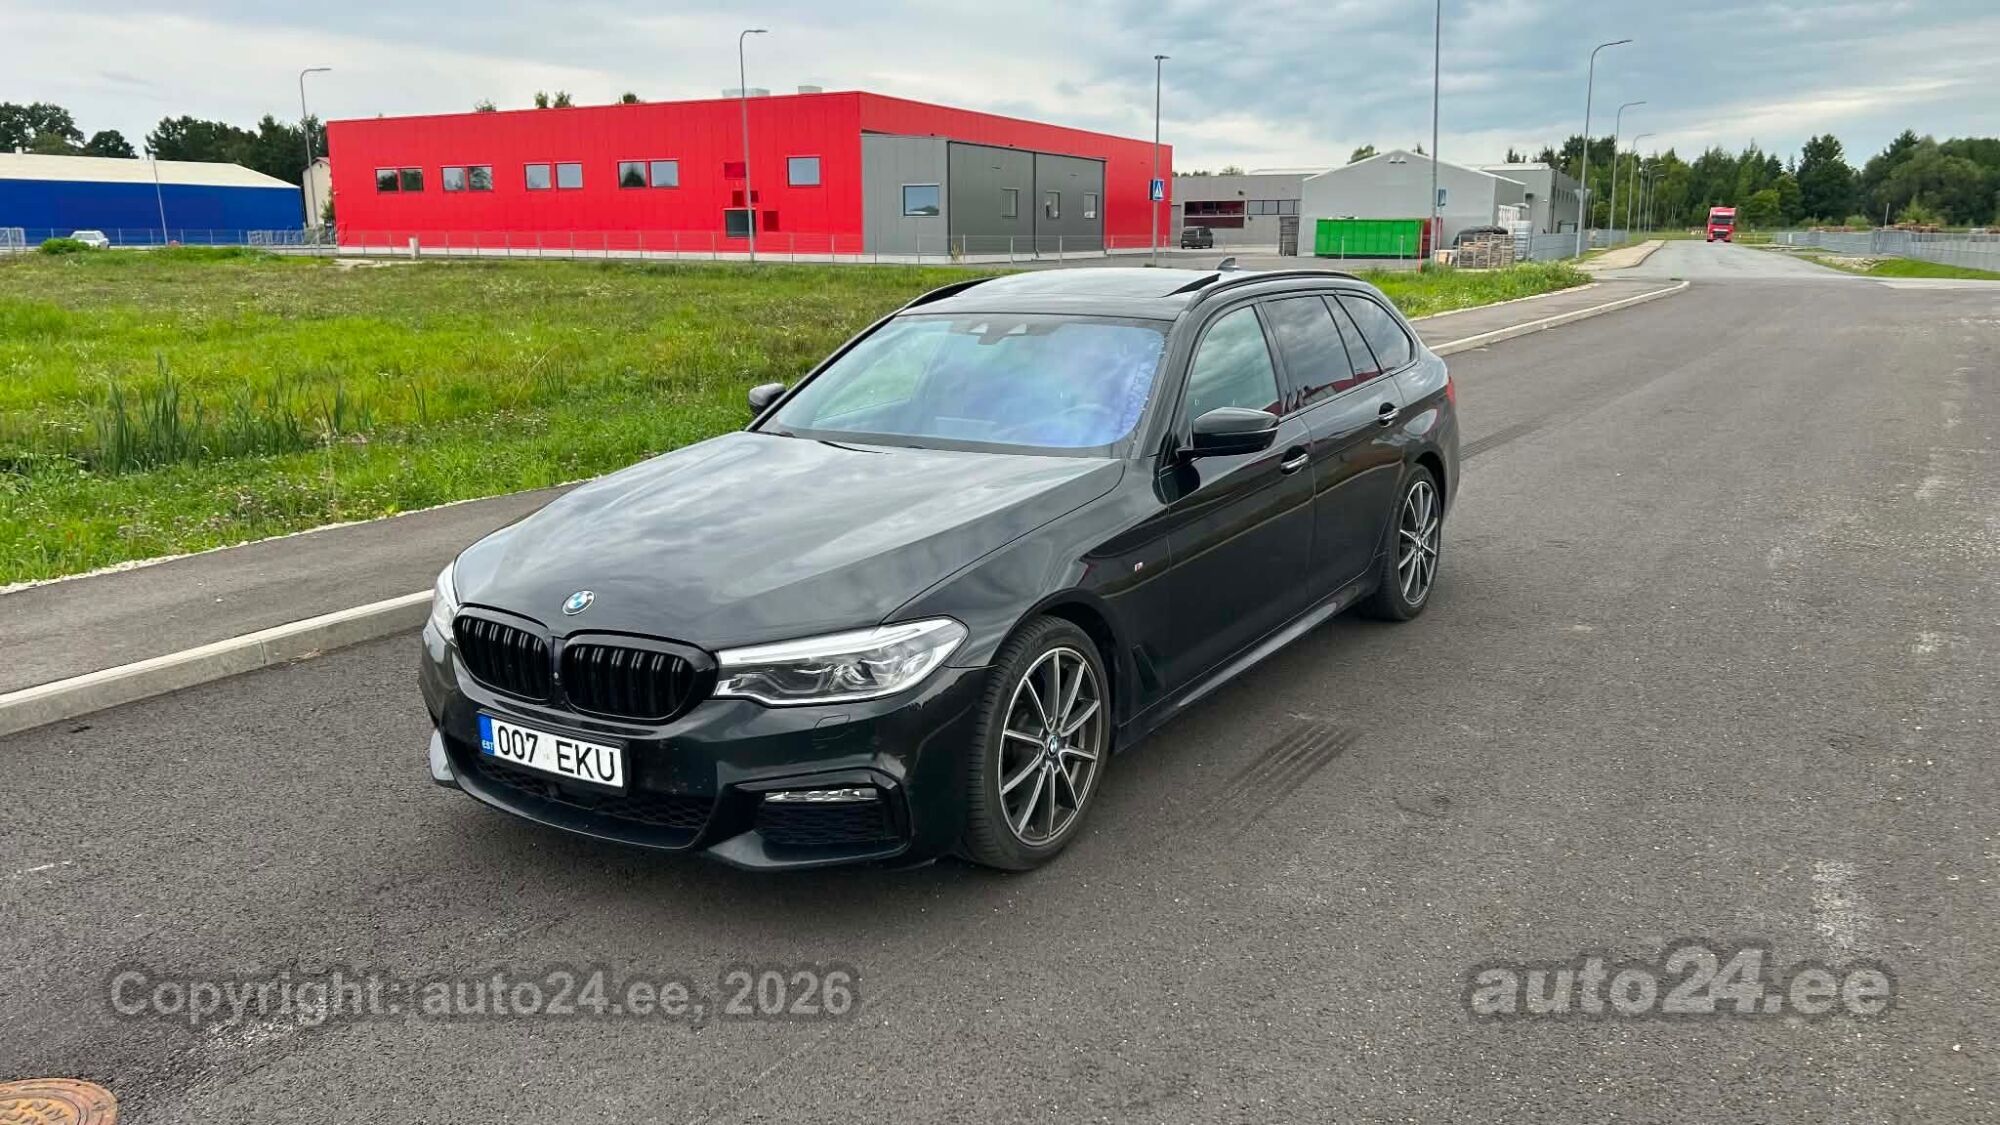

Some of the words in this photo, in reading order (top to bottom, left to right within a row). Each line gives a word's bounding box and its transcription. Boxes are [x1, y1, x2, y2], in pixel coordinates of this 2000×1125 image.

[481, 739, 494, 751] EST
[498, 725, 538, 763] 007
[556, 740, 615, 782] EKU
